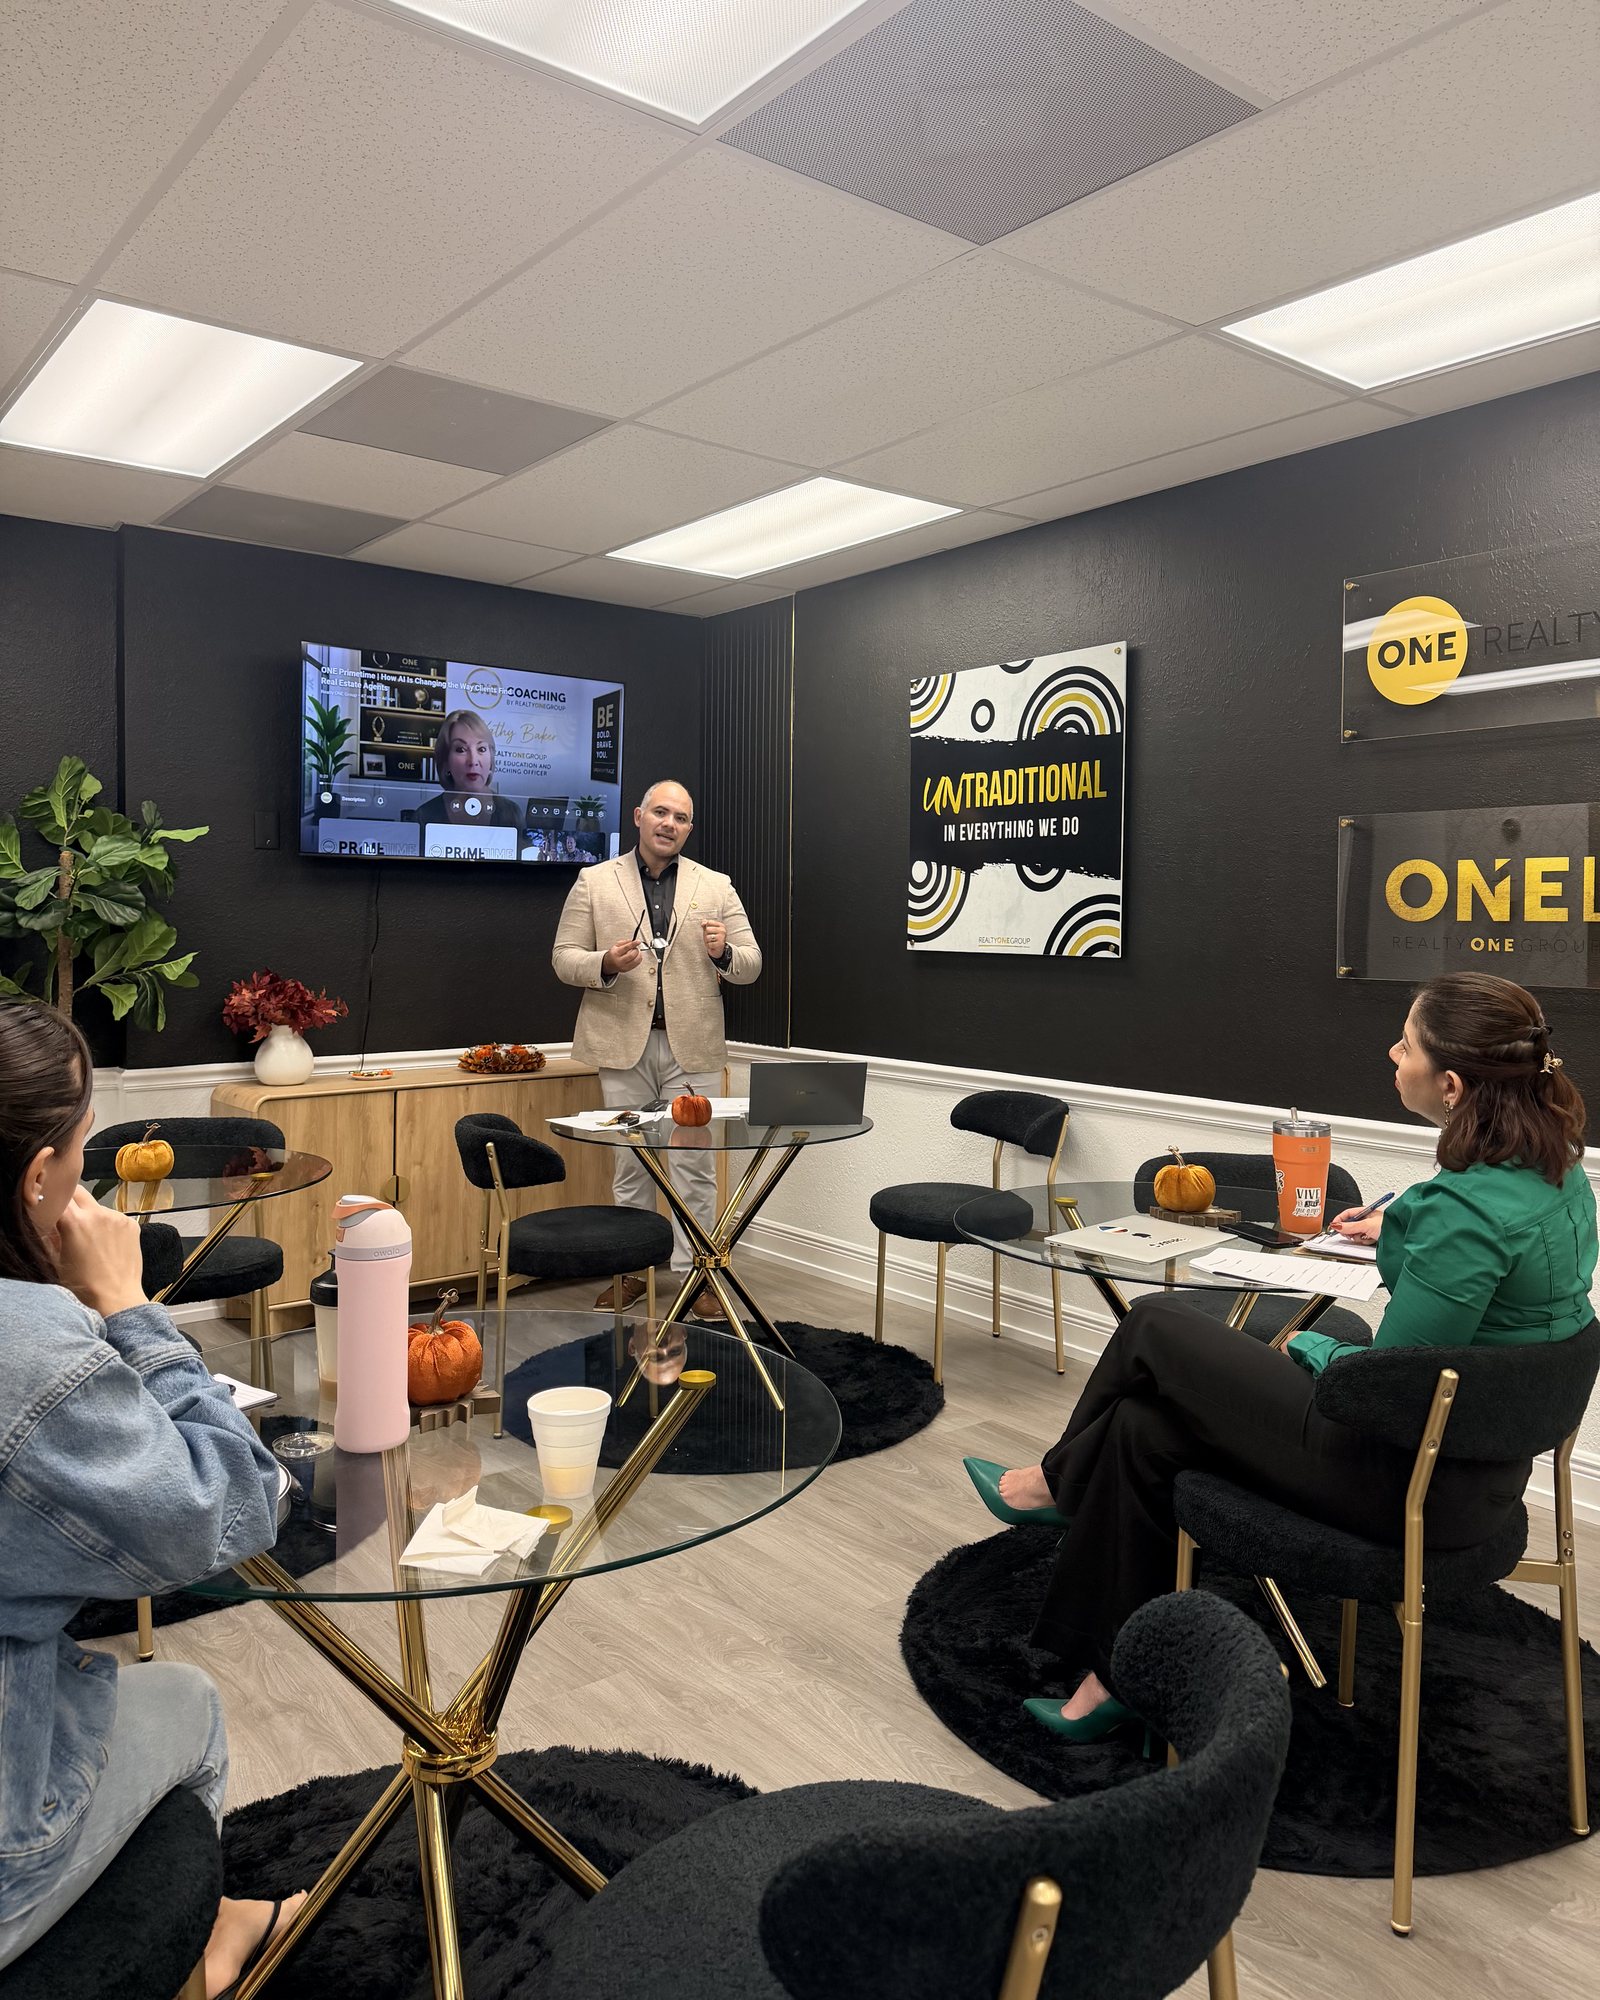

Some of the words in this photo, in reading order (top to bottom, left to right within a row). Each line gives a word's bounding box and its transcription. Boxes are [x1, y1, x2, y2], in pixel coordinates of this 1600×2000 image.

[1377, 631, 1457, 669] ONE
[402, 658, 418, 666] ONE
[321, 666, 338, 675] ONE
[339, 668, 376, 680] Primetime
[381, 673, 397, 682] How
[398, 675, 406, 683] AI
[414, 677, 447, 689] Changing
[448, 681, 458, 689] the
[459, 682, 473, 691] Way
[475, 684, 498, 693] Clients
[321, 677, 338, 686] Real
[339, 679, 362, 689] Estate
[362, 682, 389, 692] Agents
[507, 687, 566, 703] COACHING
[597, 703, 614, 728] BE
[520, 723, 558, 743] Baker
[596, 740, 613, 749] BRAVE.
[596, 751, 608, 759] YOU.
[398, 762, 415, 770] ONE
[504, 760, 538, 769] EDUCATION
[494, 767, 522, 776] OACHING
[523, 769, 548, 777] OFFICER
[923, 760, 1107, 815] UNTRADITIONAL
[944, 824, 955, 841] IN
[959, 819, 1034, 841] EVERYTHING
[1038, 817, 1058, 837] WE
[1062, 816, 1079, 836] DO
[978, 936, 1031, 945] REALTYONEGROUP
[374, 1248, 399, 1257] owala
